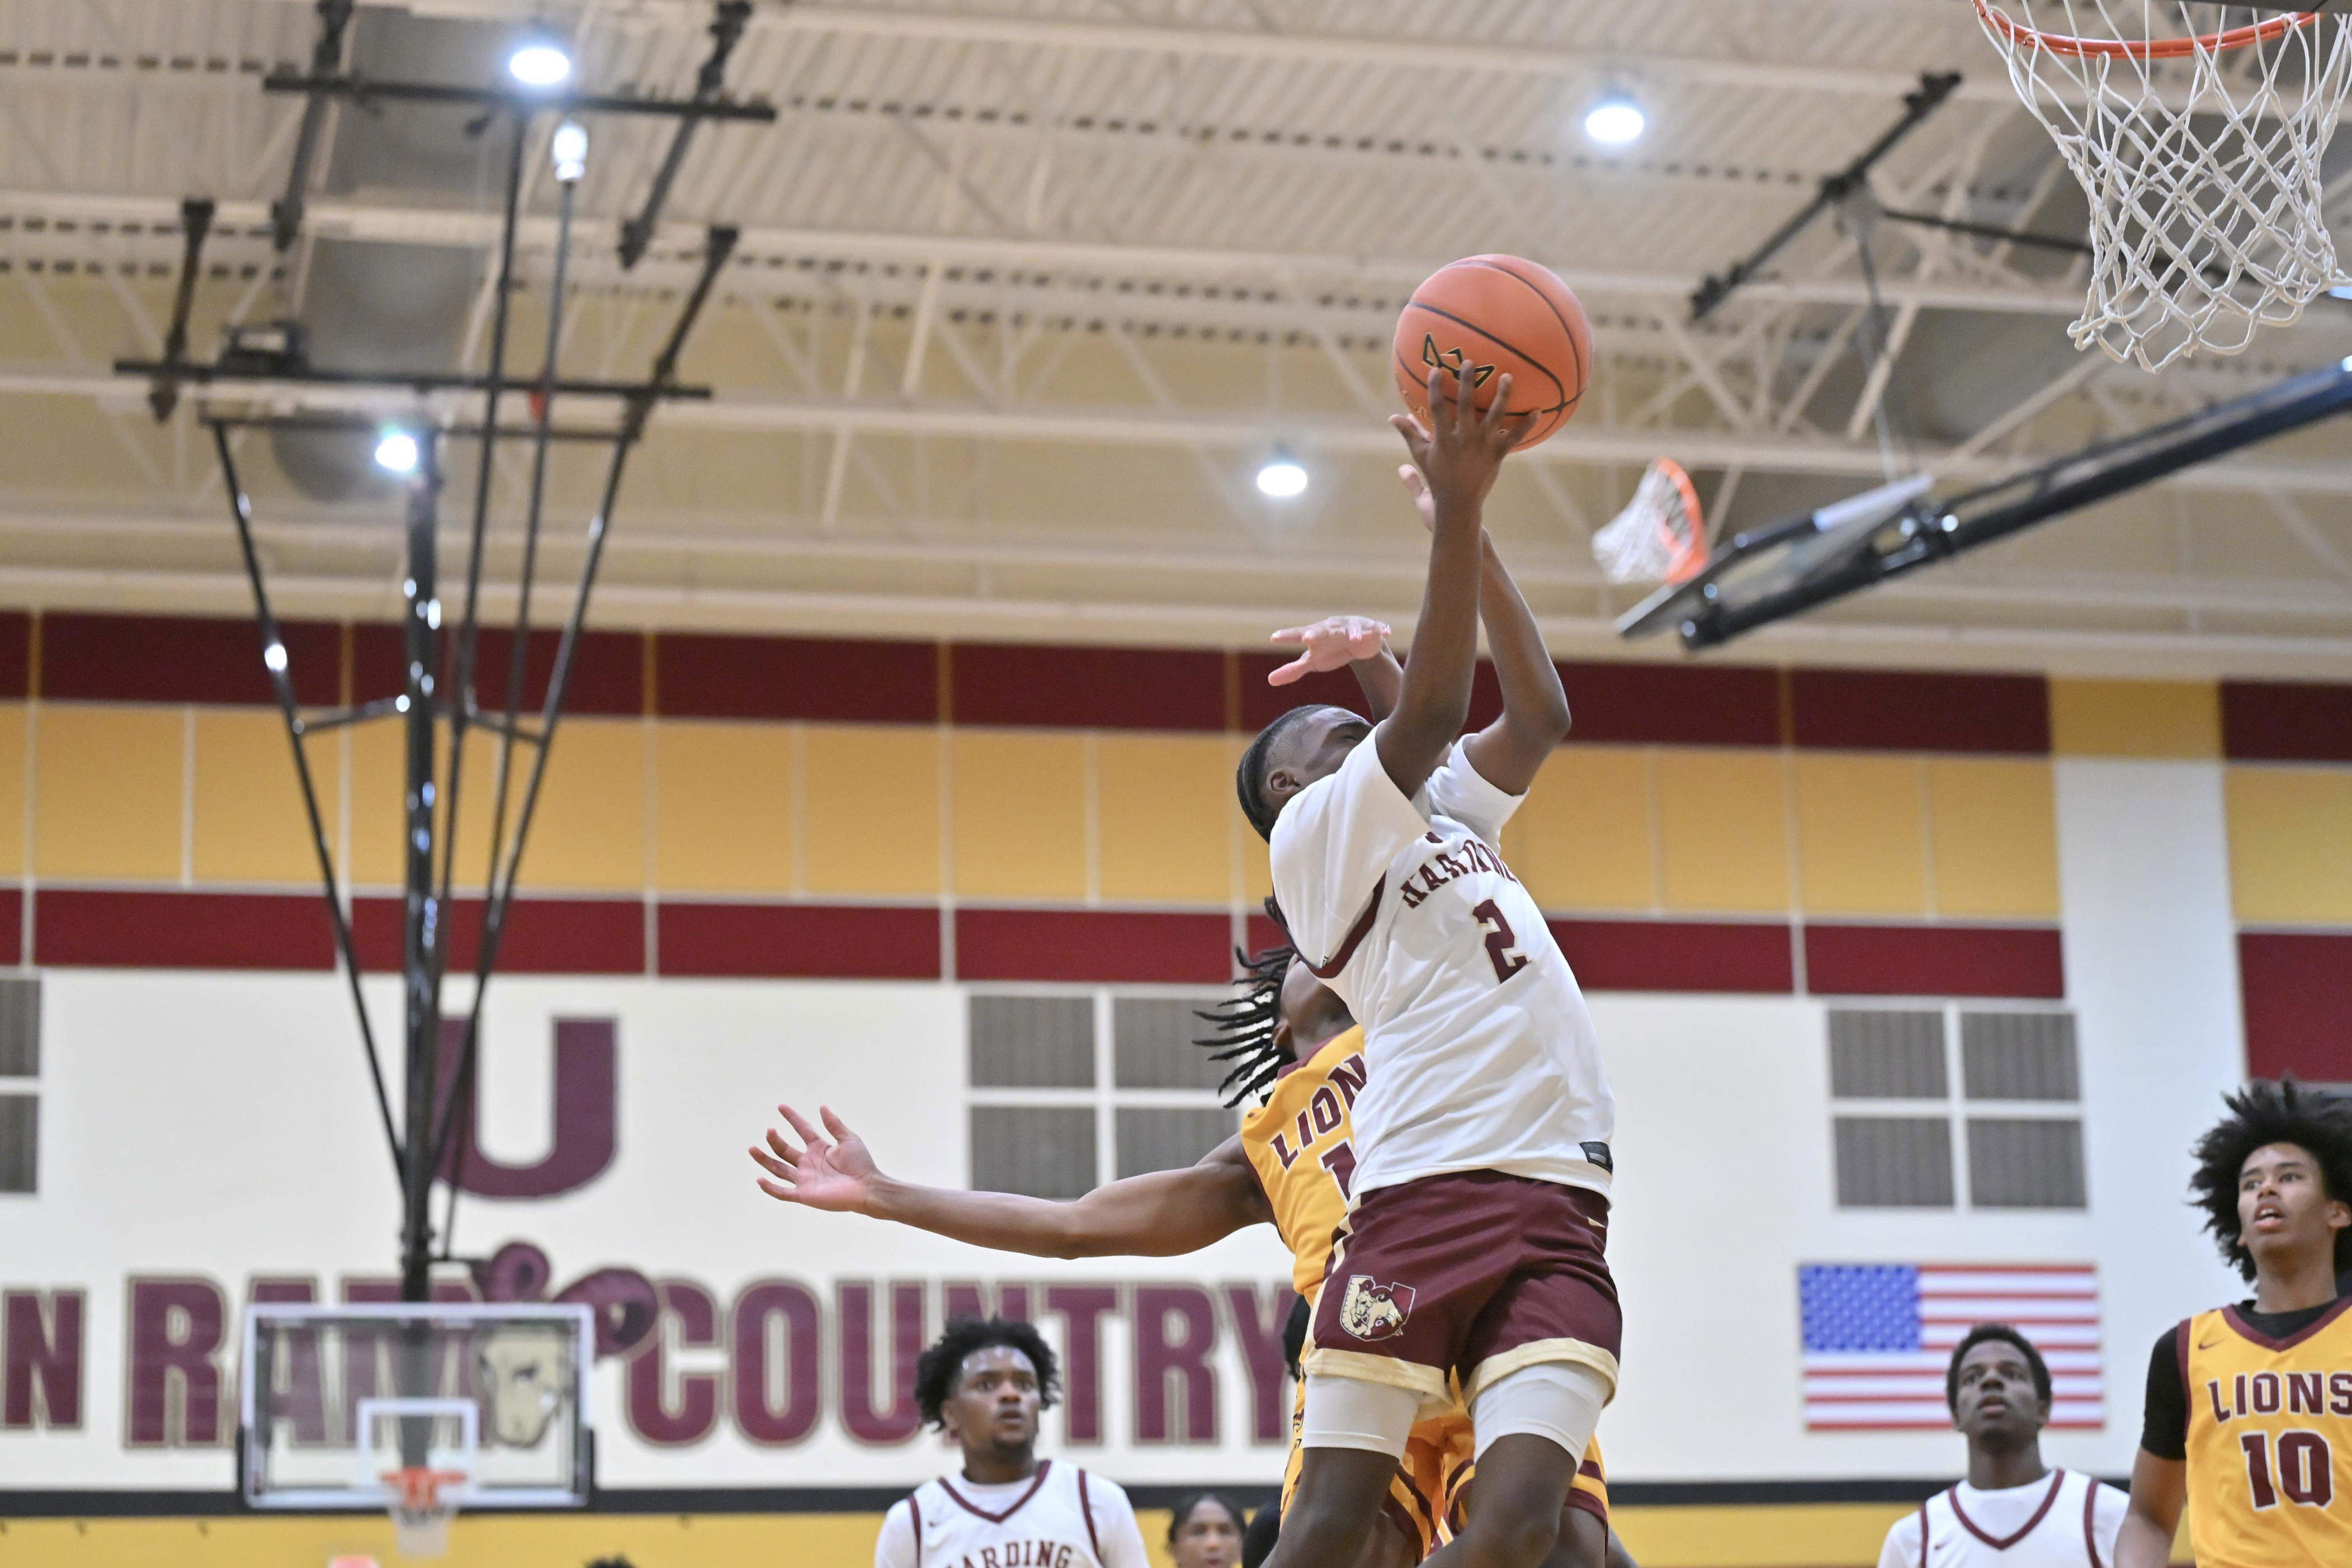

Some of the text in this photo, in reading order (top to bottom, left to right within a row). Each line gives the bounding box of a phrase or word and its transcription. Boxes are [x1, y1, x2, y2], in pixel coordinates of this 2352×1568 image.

[1471, 898, 1531, 984] 2
[1268, 1052, 1368, 1172] LION
[2205, 1370, 2352, 1424] LIONS
[2238, 1428, 2334, 1512] 10
